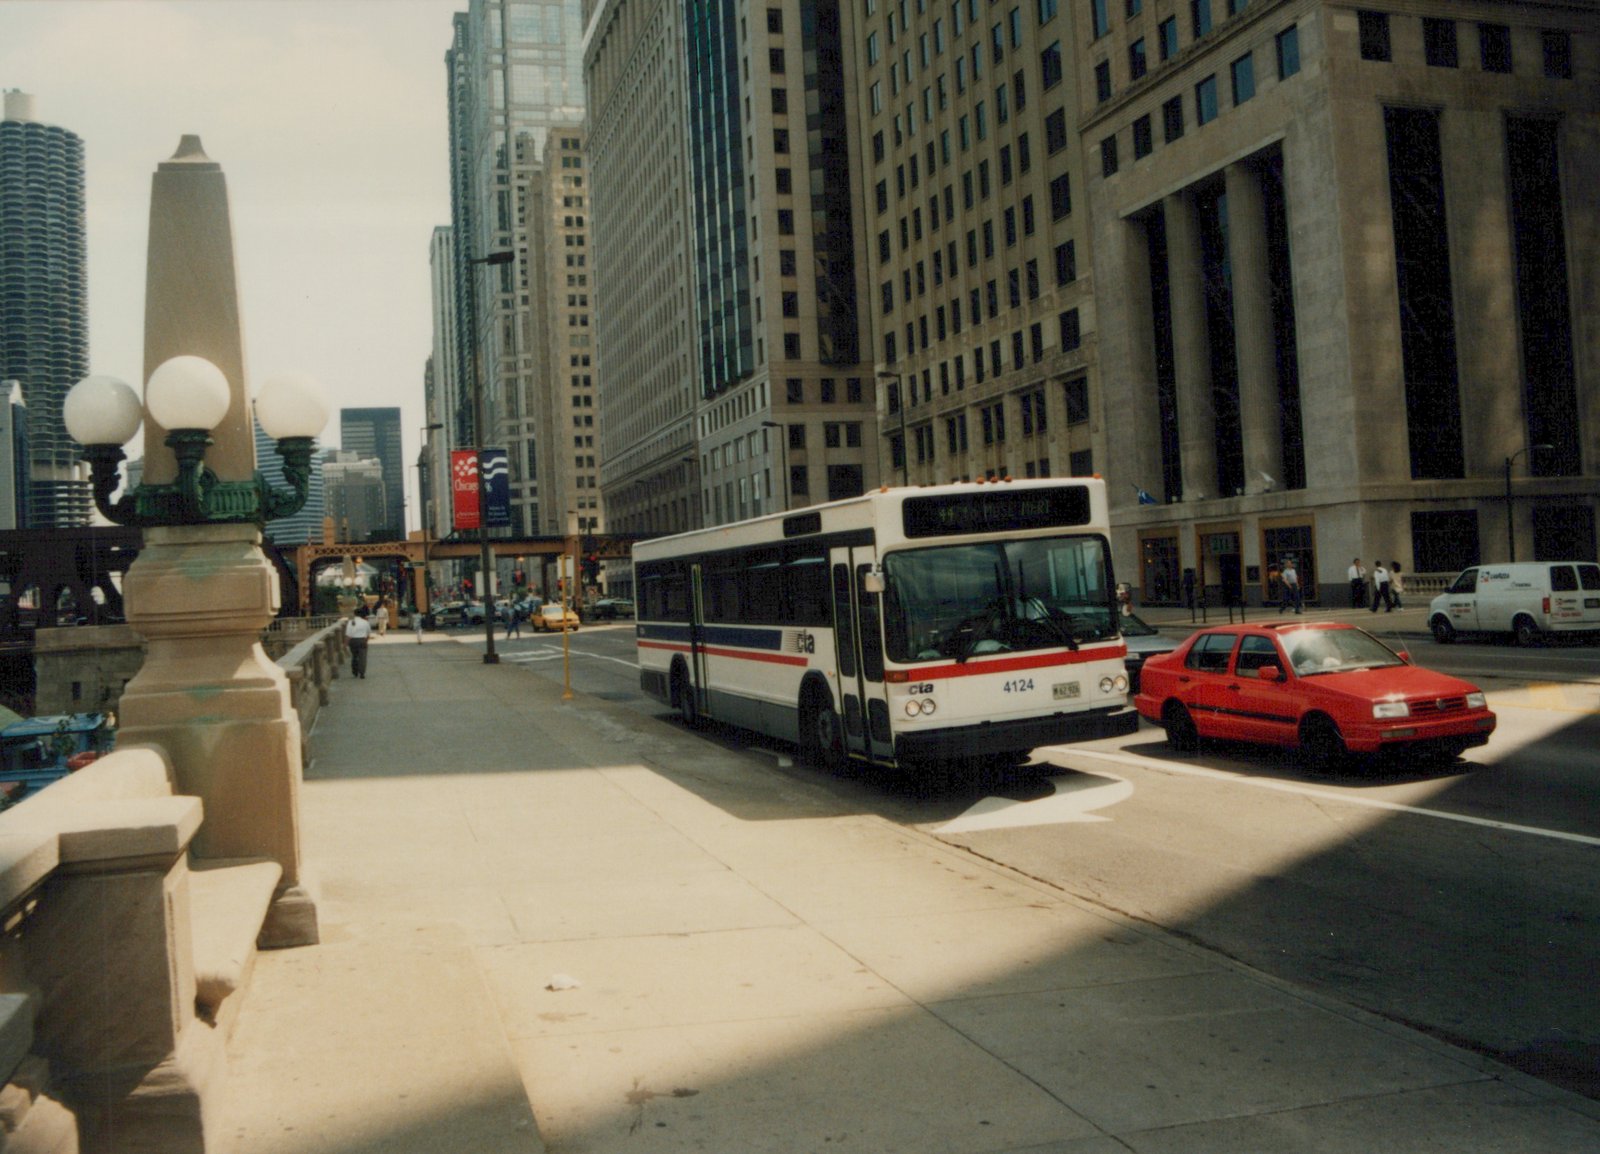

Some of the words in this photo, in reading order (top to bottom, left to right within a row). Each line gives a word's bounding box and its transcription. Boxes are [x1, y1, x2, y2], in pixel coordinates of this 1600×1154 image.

[796, 629, 815, 654] cta
[908, 682, 934, 695] cta
[1003, 678, 1035, 693] 4124
